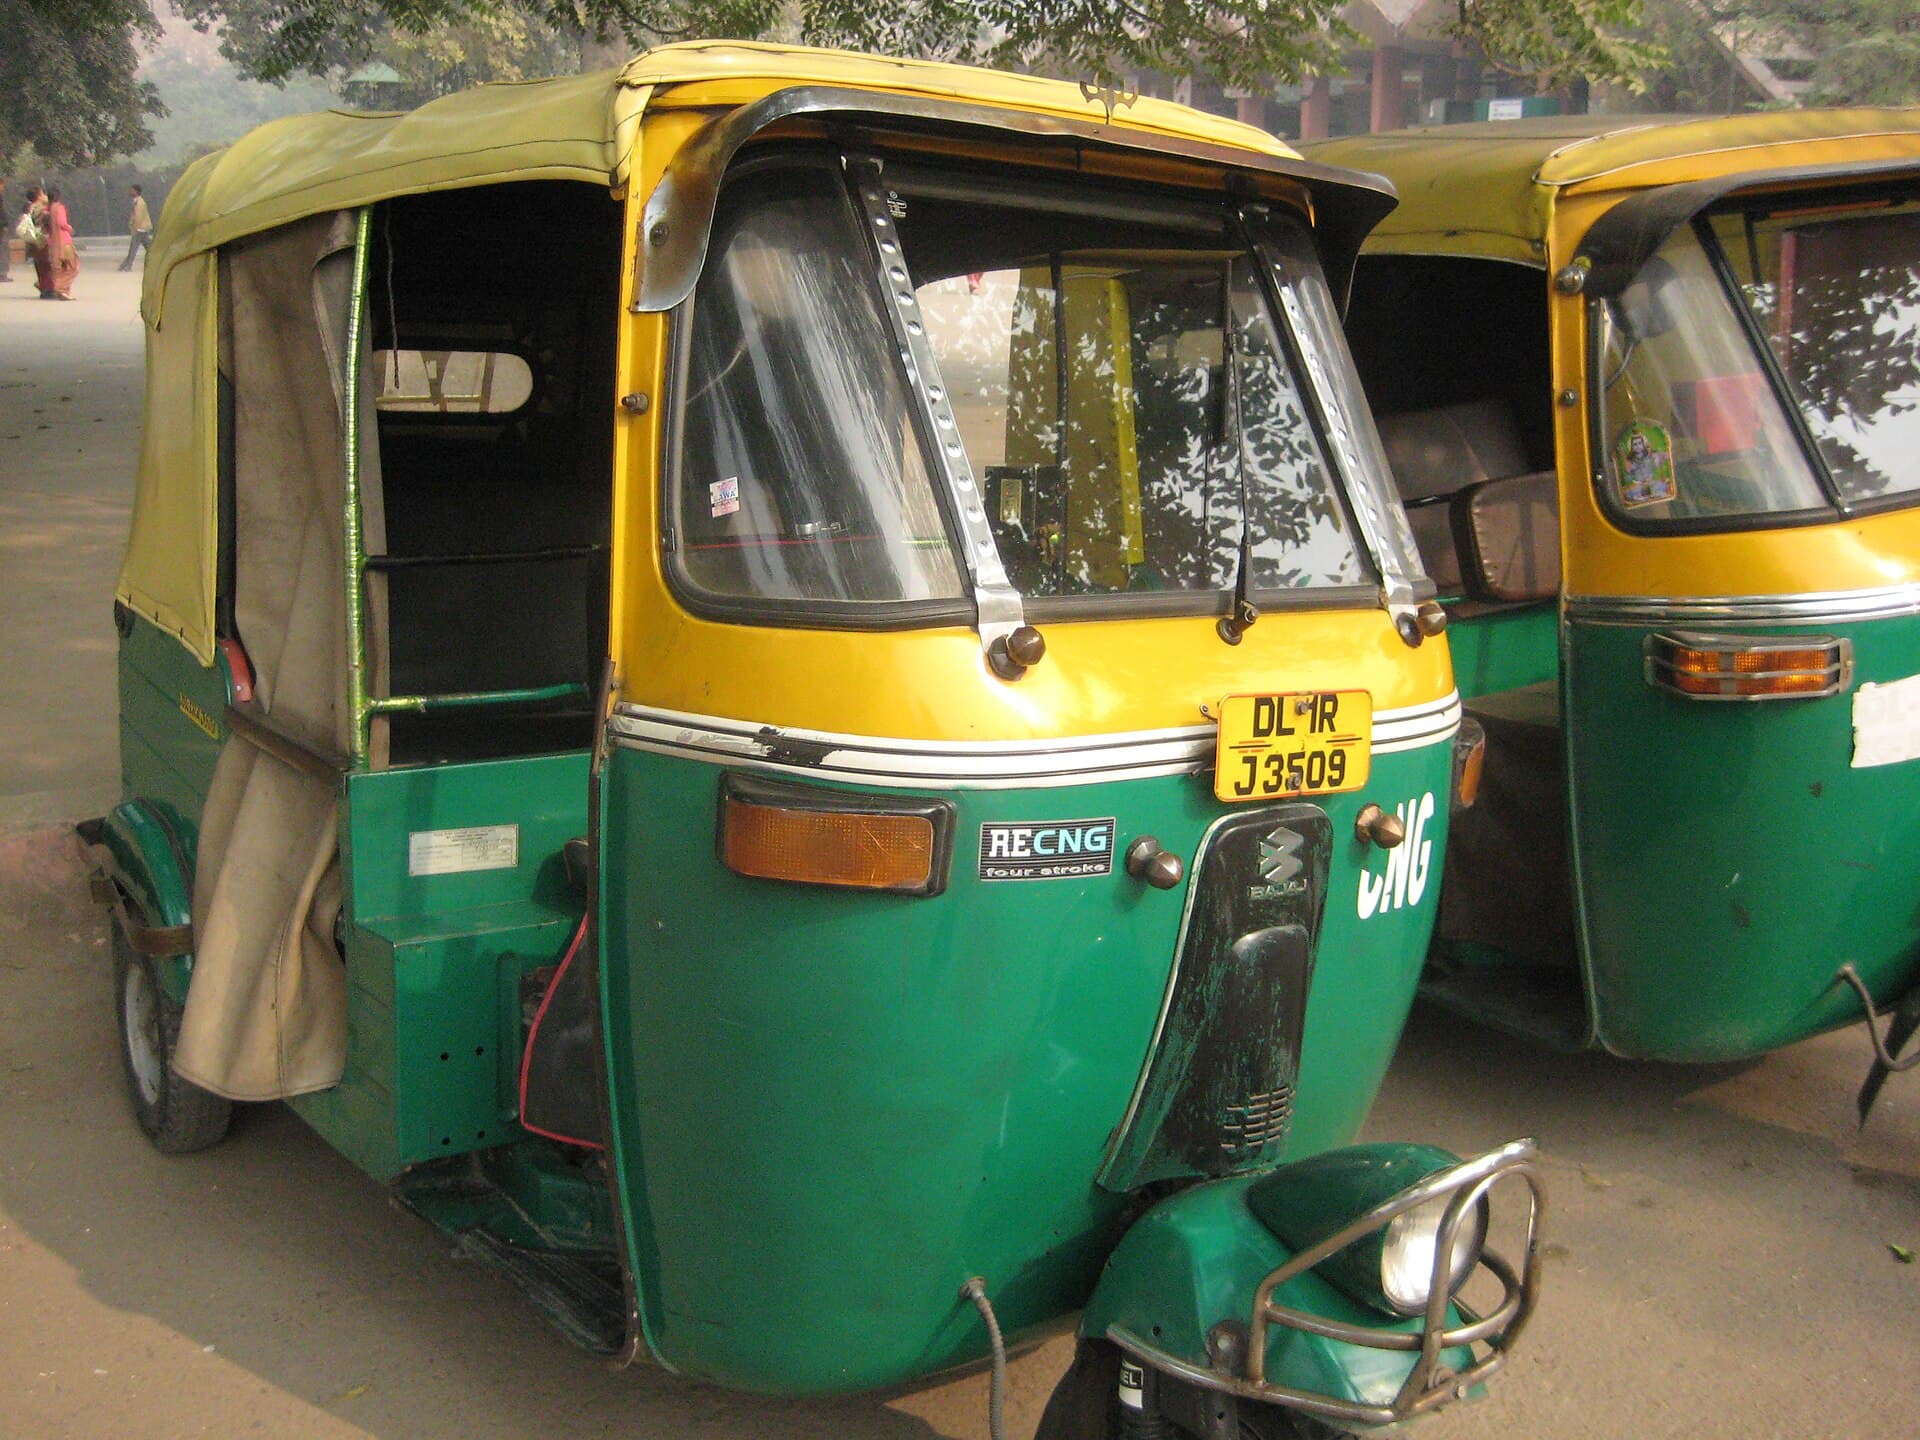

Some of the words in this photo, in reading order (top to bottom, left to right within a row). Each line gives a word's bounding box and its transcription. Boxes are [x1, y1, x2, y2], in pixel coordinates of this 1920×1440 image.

[985, 867, 1035, 878] four
[1040, 863, 1106, 876] stroke
[1248, 878, 1307, 898] BAJAJ
